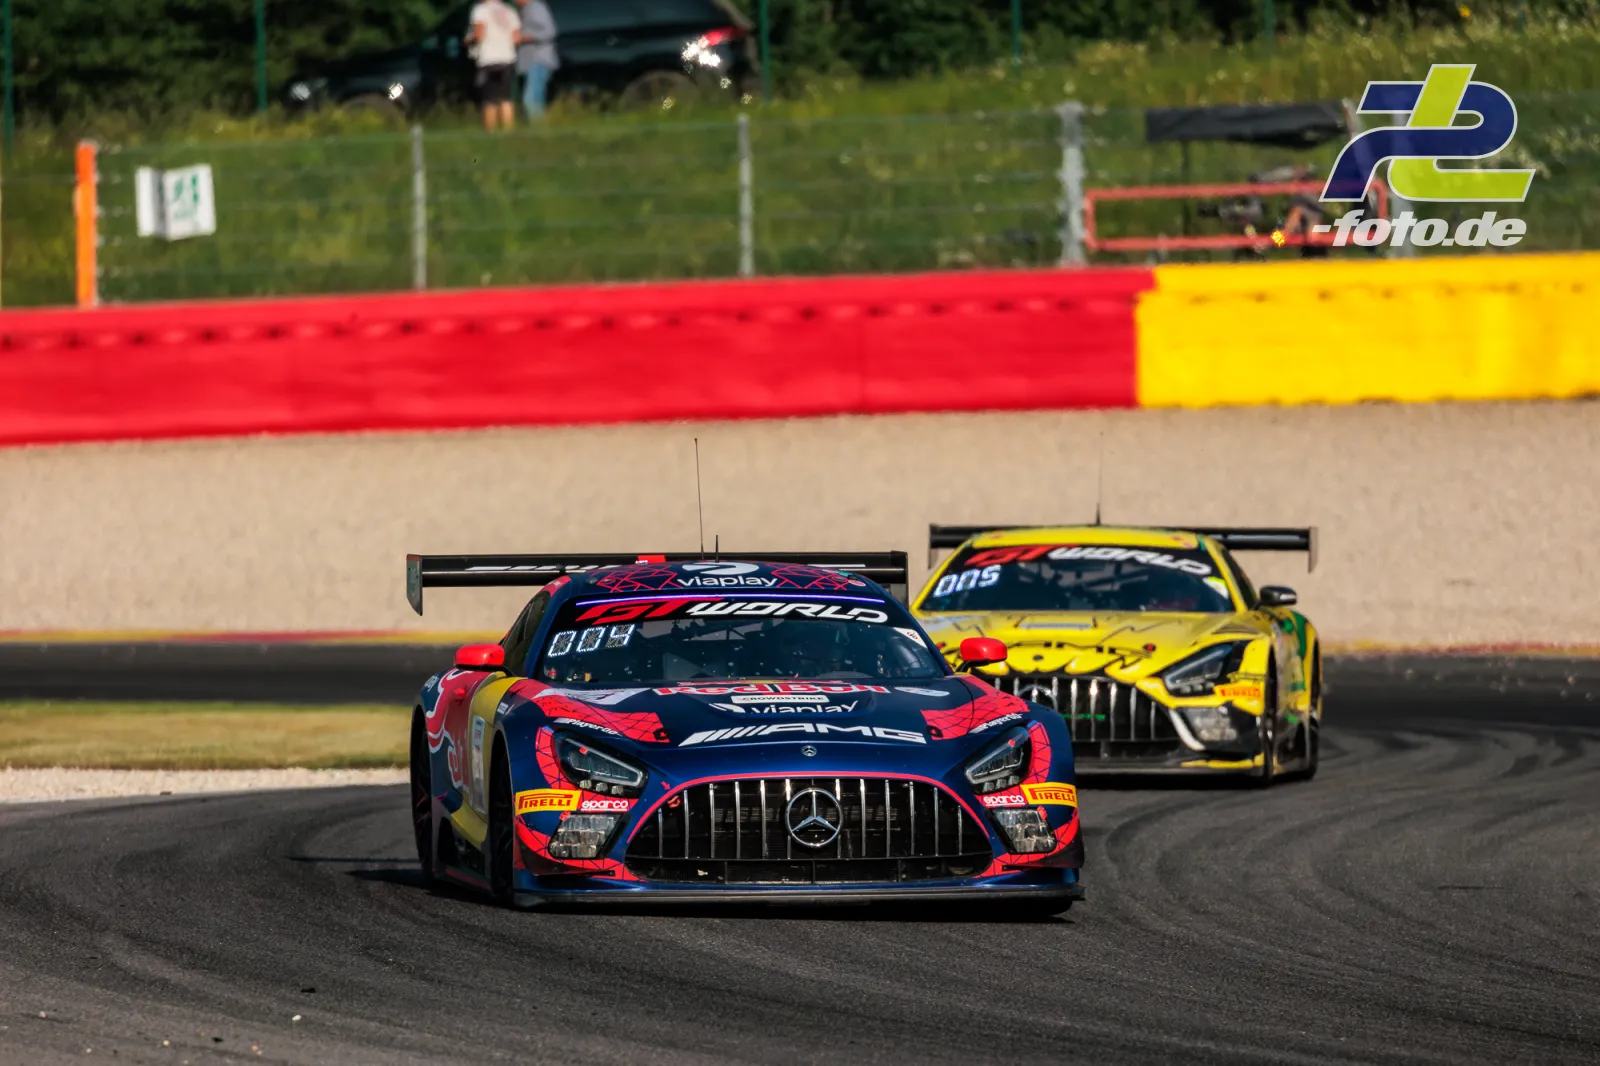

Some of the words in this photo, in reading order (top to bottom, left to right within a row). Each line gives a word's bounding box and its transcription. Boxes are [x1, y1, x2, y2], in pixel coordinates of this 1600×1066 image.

[964, 545, 1081, 567] GT
[1048, 546, 1213, 575] WORLD
[677, 575, 778, 588] viaplay
[576, 597, 724, 625] GT
[686, 601, 889, 624] WORLD
[548, 623, 635, 657] 004
[652, 683, 770, 696] Red
[773, 683, 891, 695] Bull
[760, 722, 927, 744] AMG
[518, 794, 574, 810] PIRELLI
[983, 794, 1025, 804] sparco
[1028, 786, 1076, 803] PIRELLI
[581, 799, 629, 810] sparco
